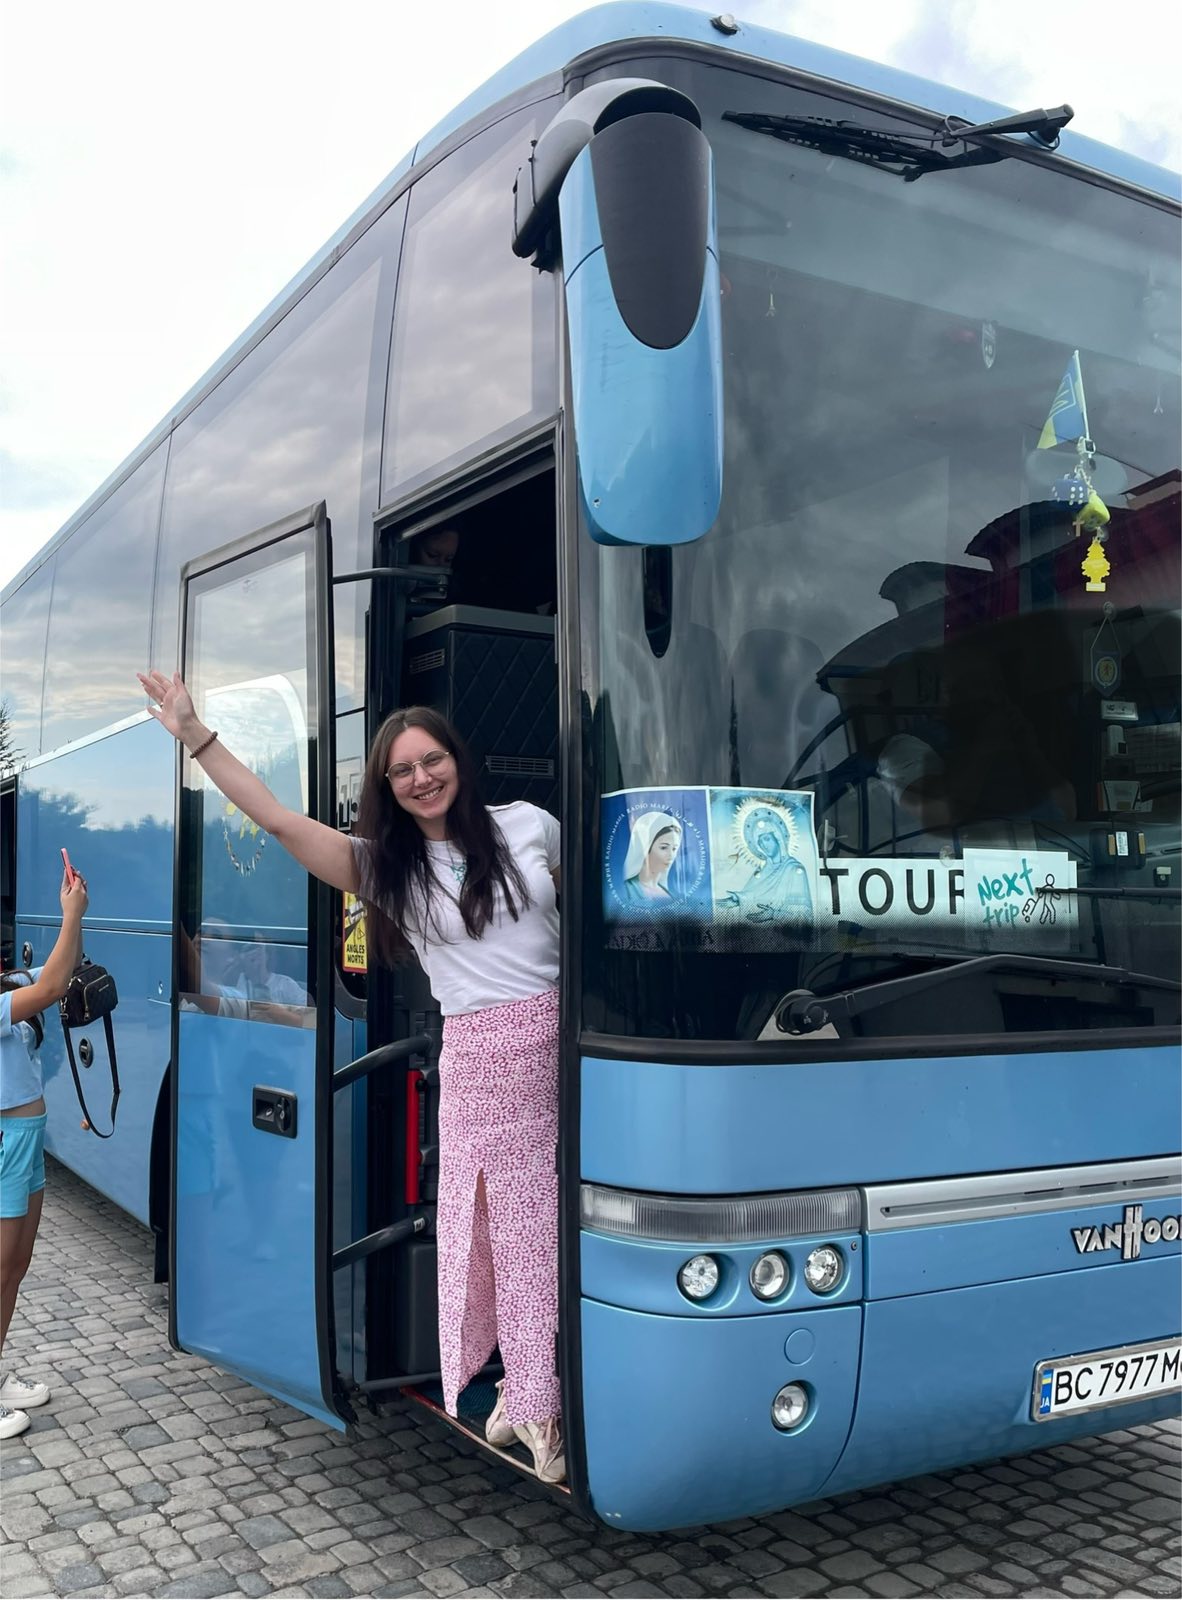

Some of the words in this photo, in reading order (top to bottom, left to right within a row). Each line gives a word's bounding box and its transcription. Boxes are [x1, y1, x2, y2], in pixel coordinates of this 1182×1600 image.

[977, 858, 1035, 906] Next
[982, 902, 1020, 928] trip
[346, 943, 365, 954] ANGLES
[347, 954, 364, 964] MORTS
[1072, 1204, 1182, 1259] VANHOO
[1054, 1367, 1093, 1406] BC
[1098, 1353, 1159, 1396] 7977
[1161, 1349, 1182, 1383] M
